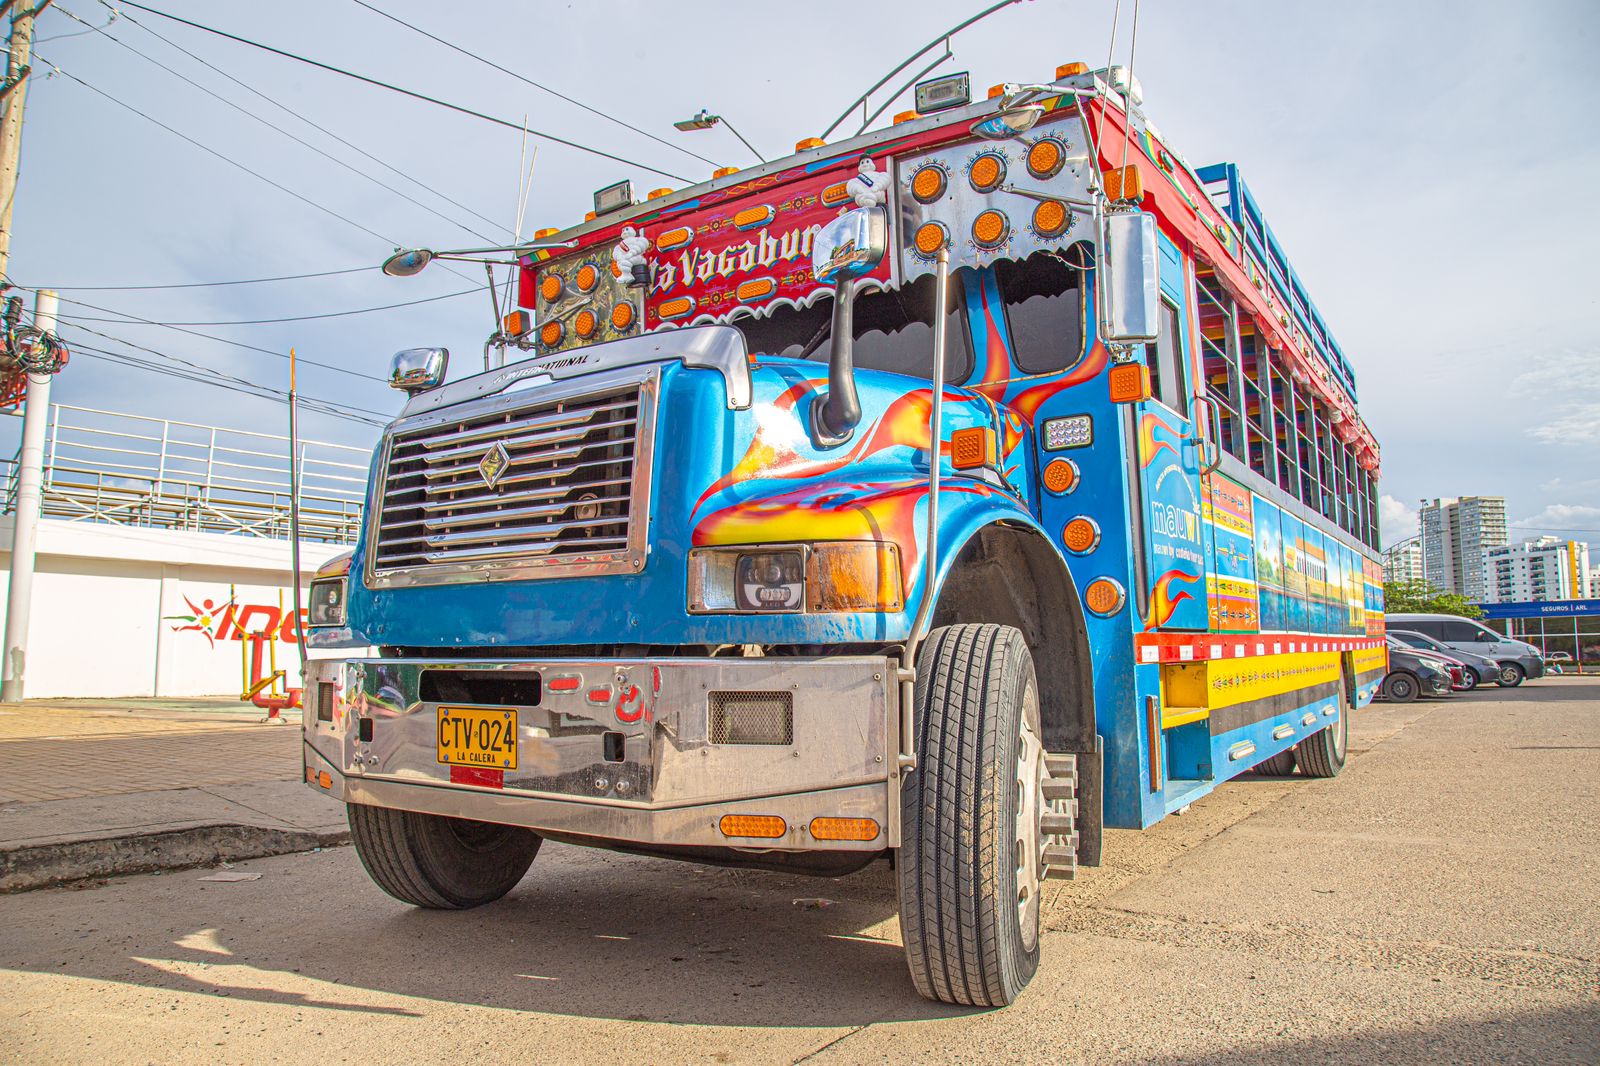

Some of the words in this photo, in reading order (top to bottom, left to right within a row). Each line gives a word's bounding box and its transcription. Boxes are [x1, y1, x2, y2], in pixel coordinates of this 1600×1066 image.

[440, 717, 474, 750] CTV
[478, 719, 515, 753] 024
[457, 751, 466, 761] LA
[469, 752, 496, 763] CALERA
